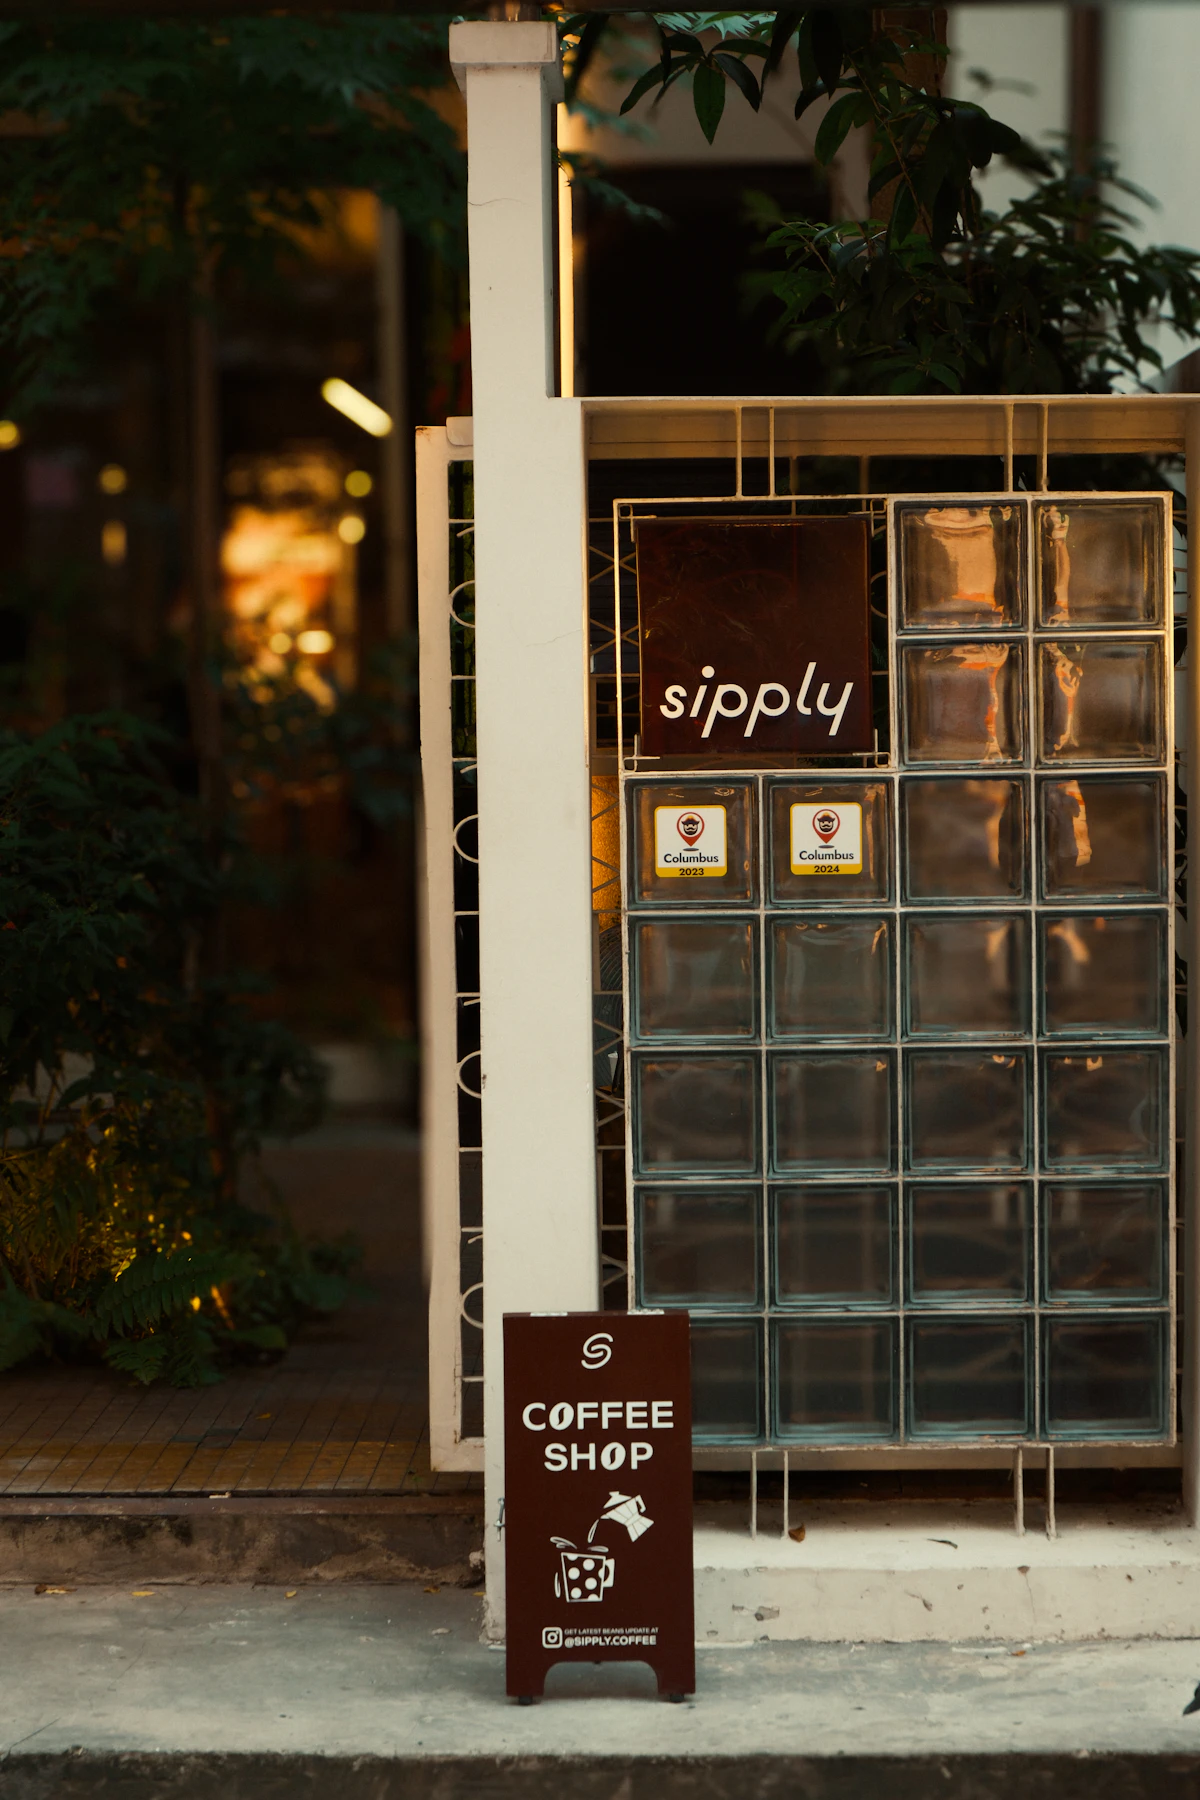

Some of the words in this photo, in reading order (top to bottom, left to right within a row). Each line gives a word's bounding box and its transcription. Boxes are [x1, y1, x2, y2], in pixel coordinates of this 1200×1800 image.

[659, 662, 854, 738] sipply
[663, 852, 719, 864] Columbus
[799, 850, 855, 861] Columbus
[679, 867, 705, 876] 2023
[814, 865, 840, 874] 2024
[522, 1401, 674, 1431] COFFEE
[543, 1441, 653, 1472] SHOP
[564, 1635, 657, 1648] @SIPPLY.COFFEE
